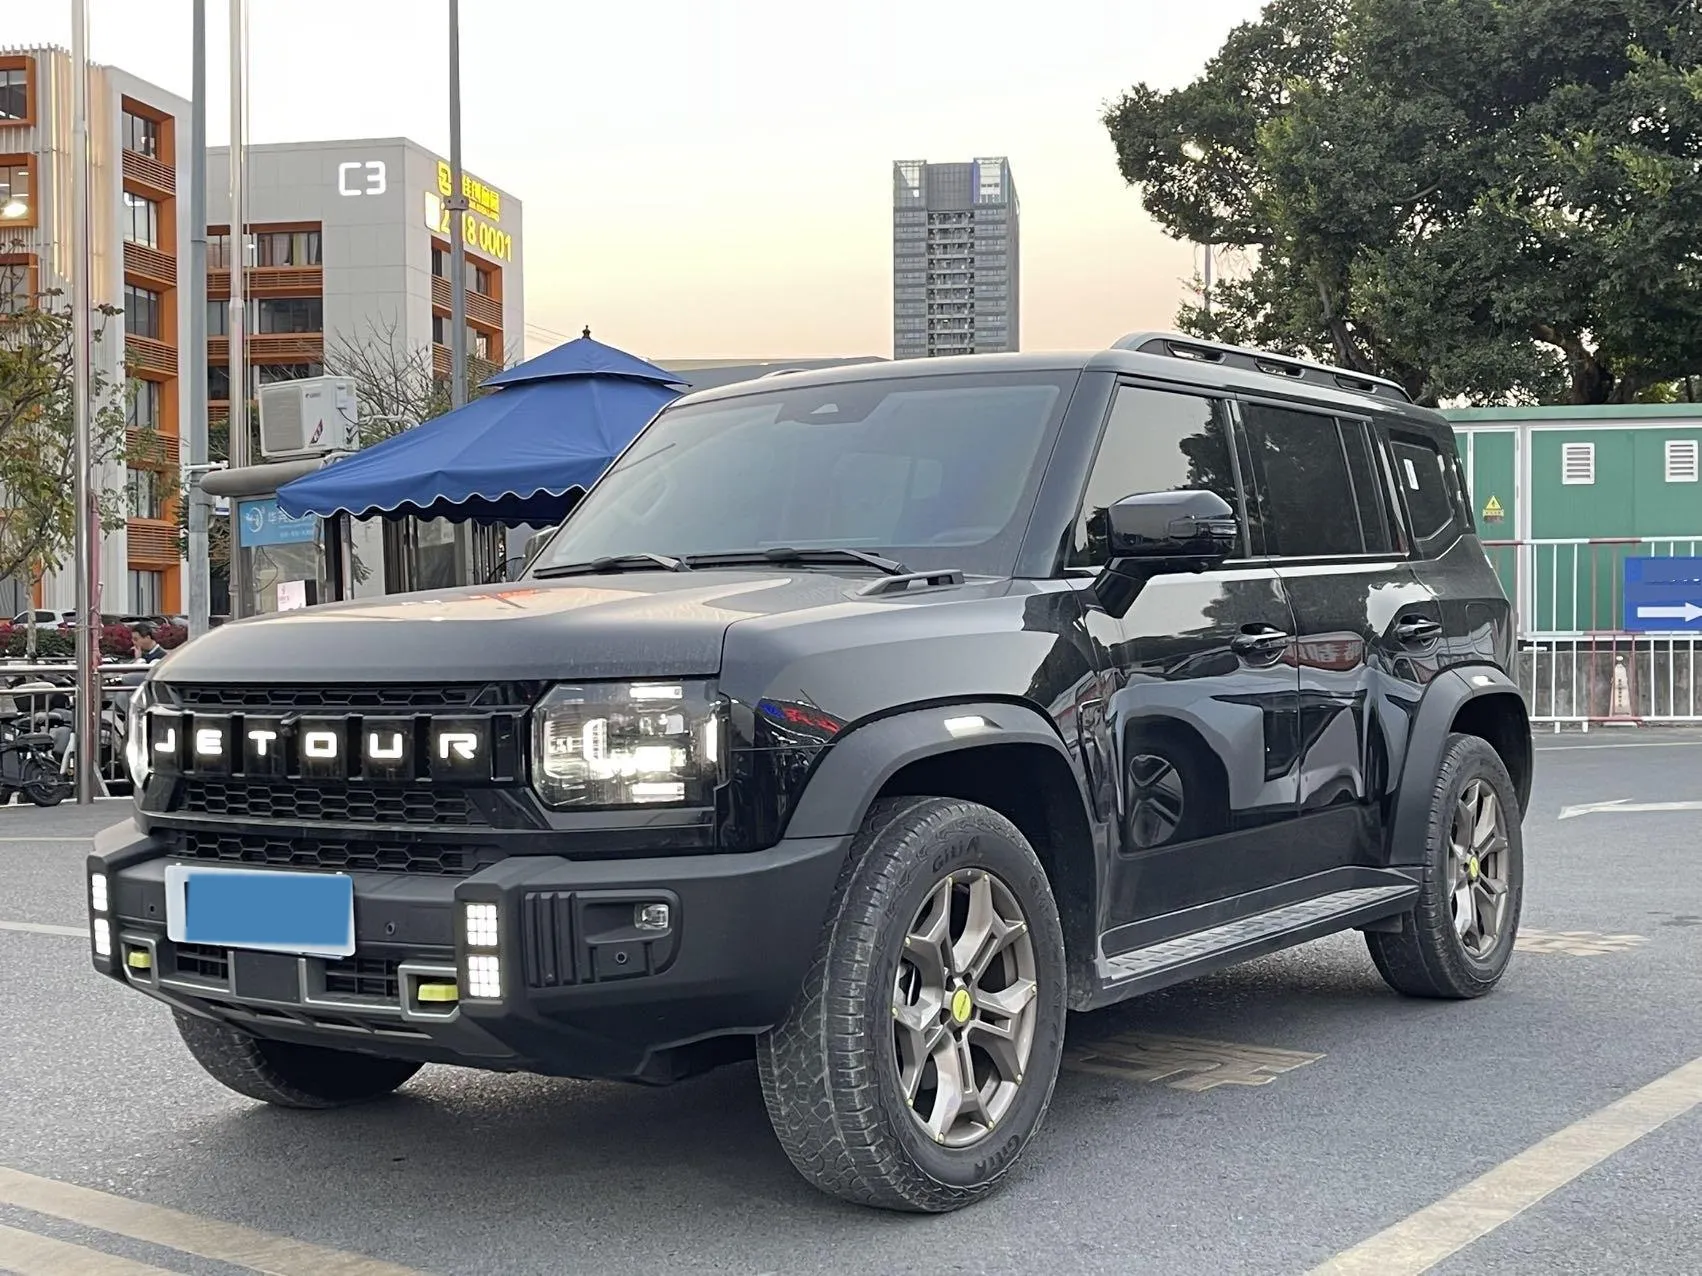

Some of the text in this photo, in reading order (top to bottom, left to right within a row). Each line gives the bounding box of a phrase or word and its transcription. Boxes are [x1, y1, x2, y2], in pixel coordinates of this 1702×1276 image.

[339, 161, 386, 196] C3
[480, 221, 511, 262] 0001
[154, 728, 478, 759] JETOUR
